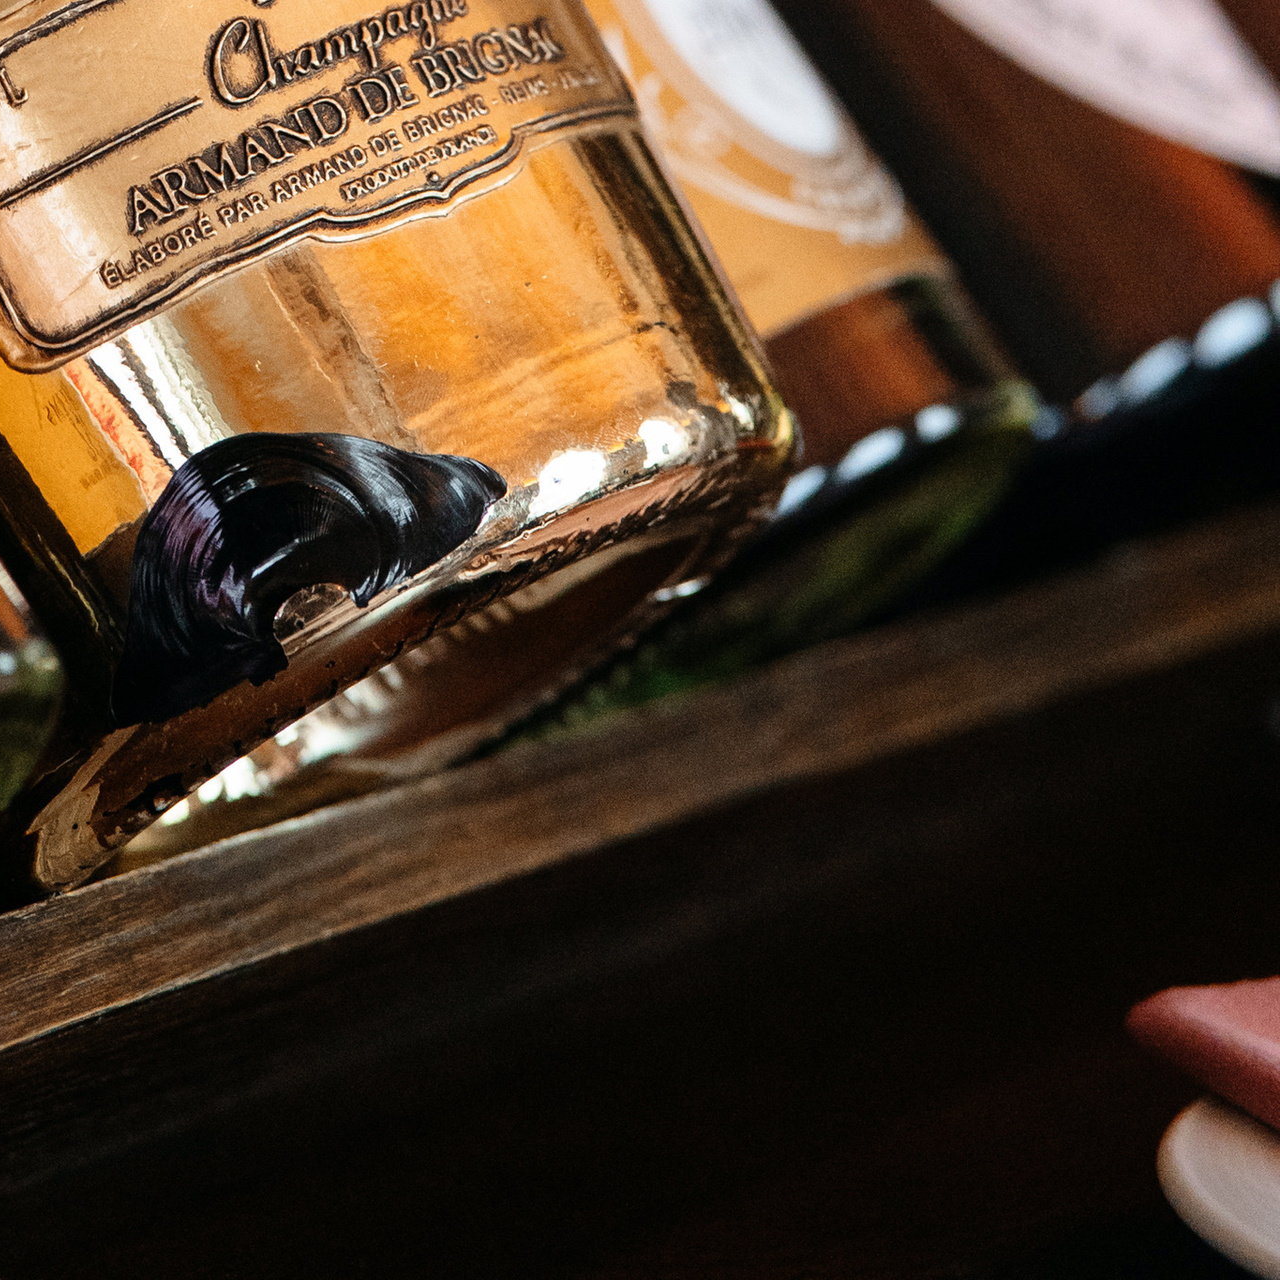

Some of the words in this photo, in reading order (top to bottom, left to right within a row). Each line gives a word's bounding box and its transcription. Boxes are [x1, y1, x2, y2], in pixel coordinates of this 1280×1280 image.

[99, 211, 218, 288] ÉLABORÉ
[219, 192, 269, 228] PAR
[272, 146, 367, 204] ARMAND
[369, 129, 403, 157] DE
[403, 94, 489, 142] BRIGNAC
[128, 97, 348, 233] ARMAND
[345, 65, 420, 124] DE
[341, 153, 417, 200] PRODUIT
[415, 148, 441, 170] DE
[438, 125, 498, 163] FRANCE
